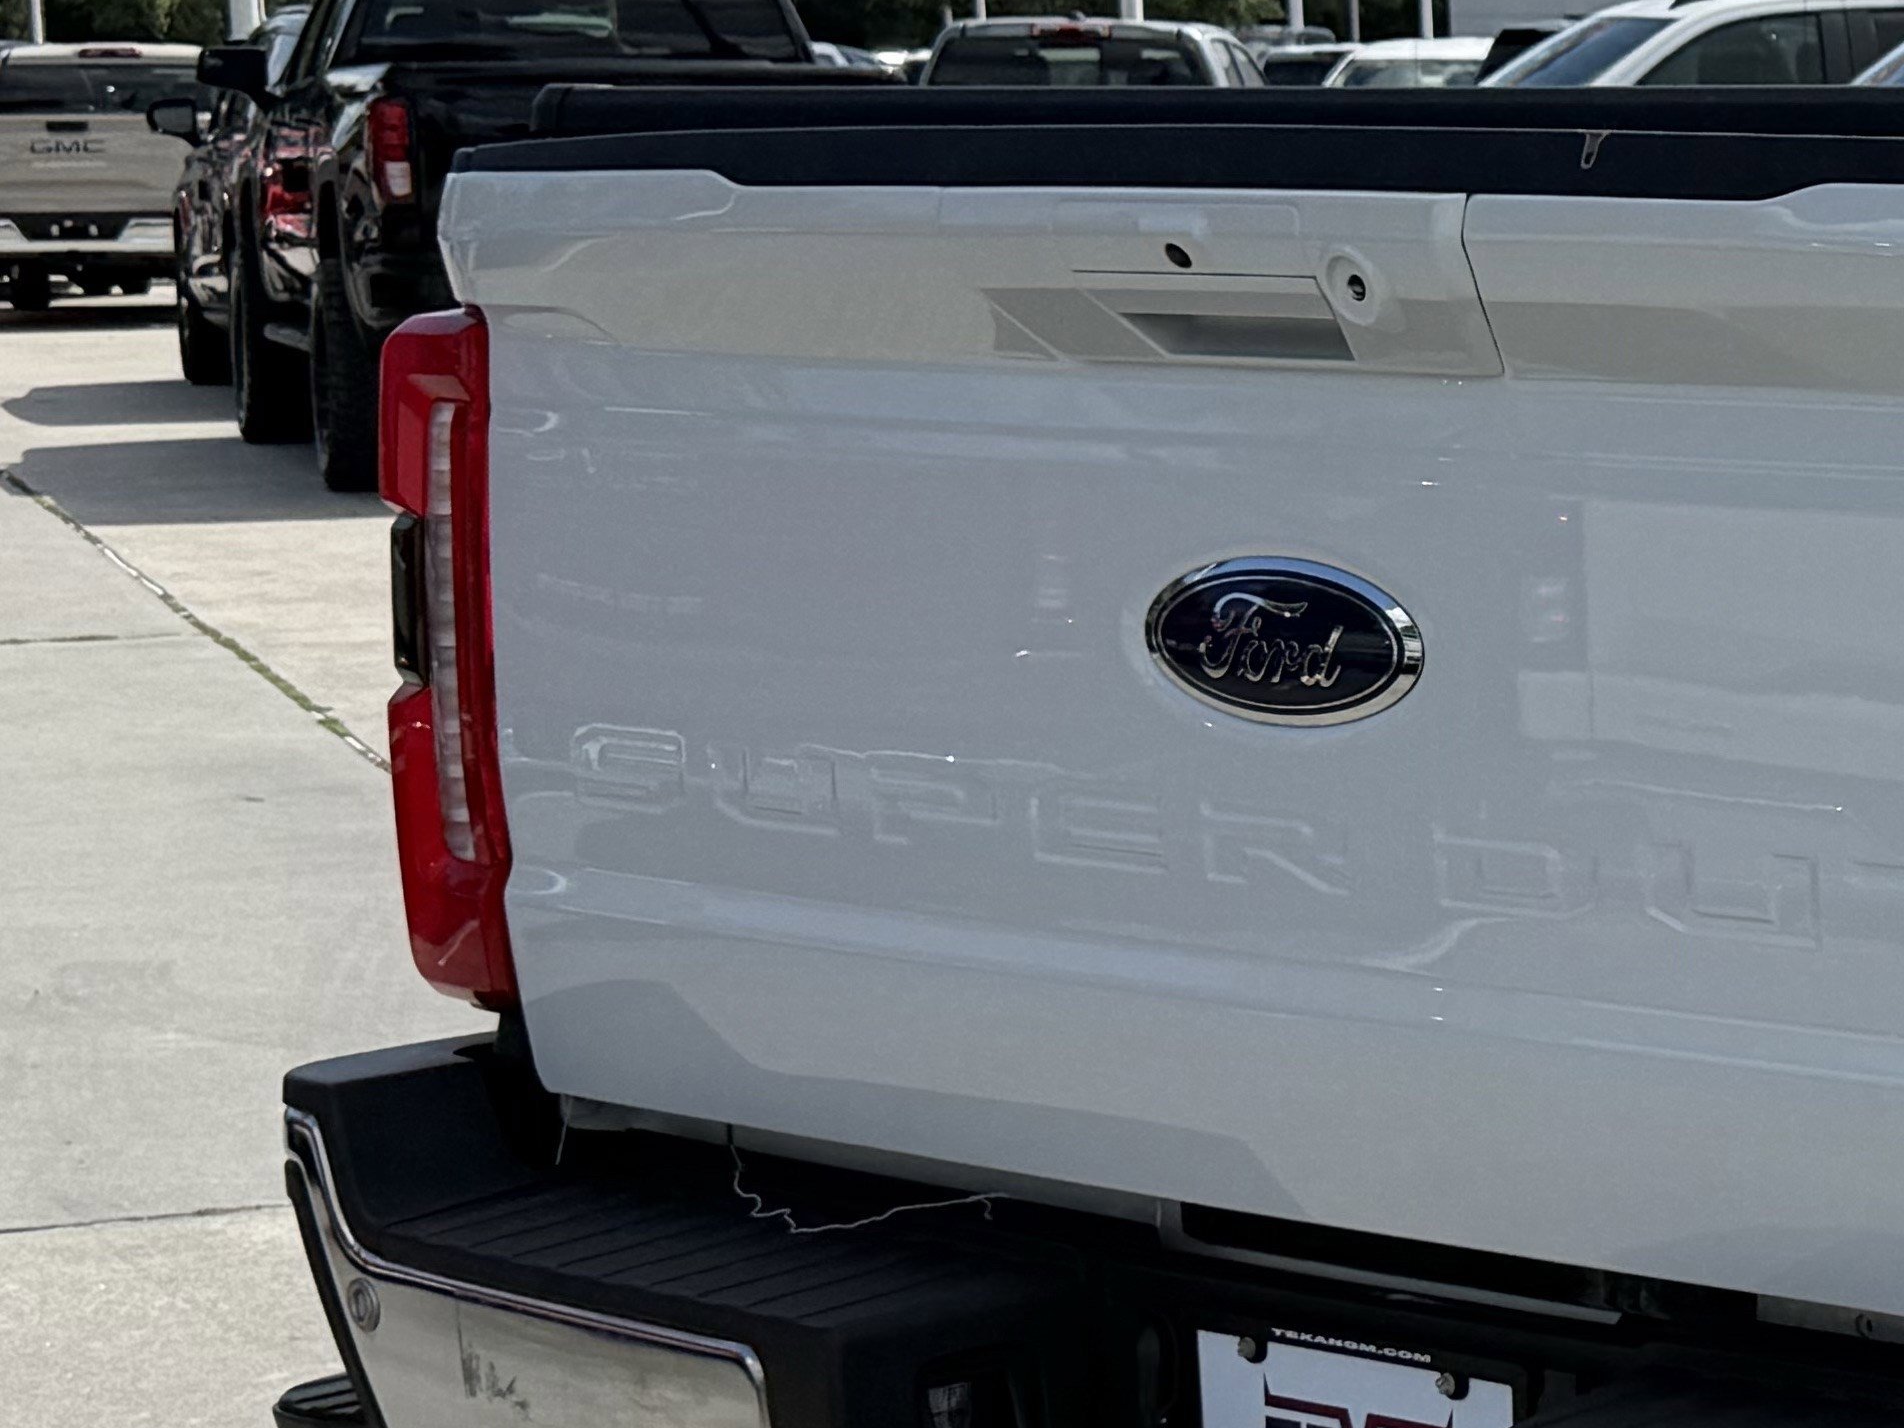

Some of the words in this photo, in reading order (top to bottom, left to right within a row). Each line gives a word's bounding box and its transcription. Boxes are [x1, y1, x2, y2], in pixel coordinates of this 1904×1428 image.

[29, 138, 107, 155] GMC
[1199, 591, 1344, 688] Ford
[571, 722, 1350, 897] SUPER
